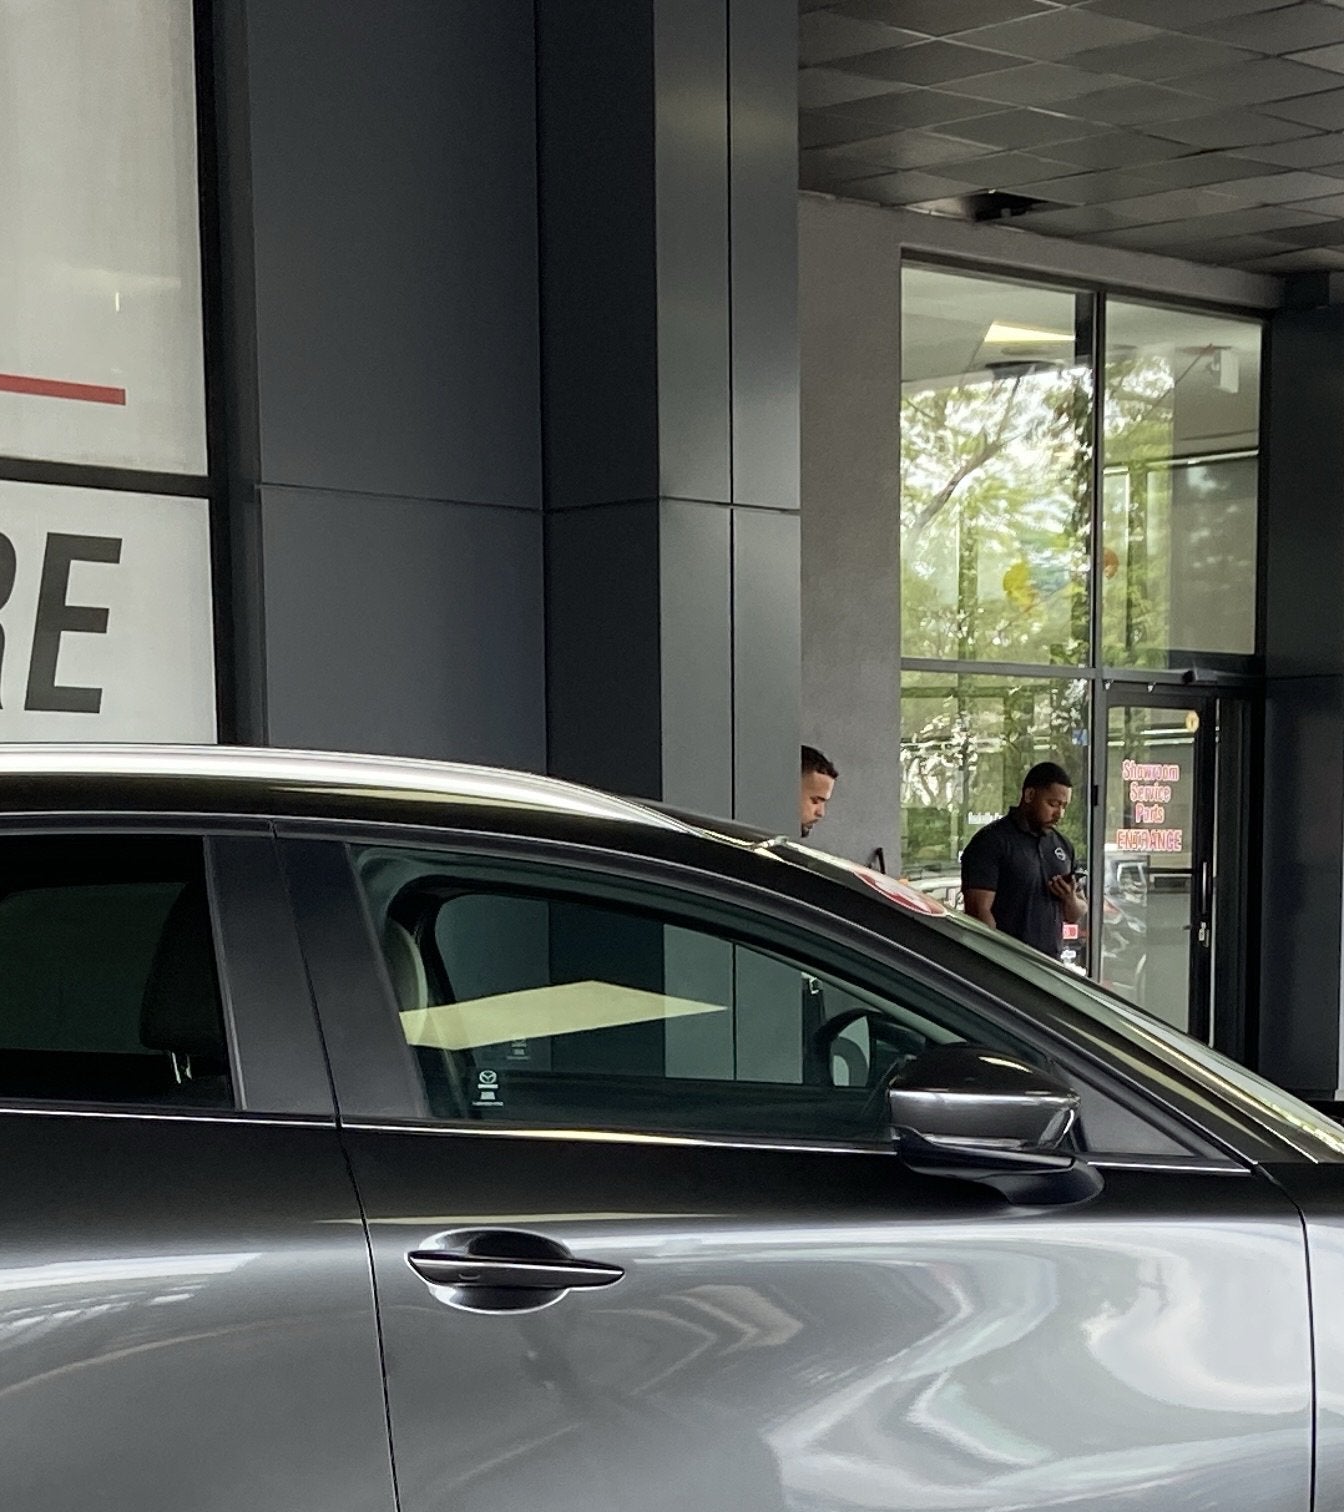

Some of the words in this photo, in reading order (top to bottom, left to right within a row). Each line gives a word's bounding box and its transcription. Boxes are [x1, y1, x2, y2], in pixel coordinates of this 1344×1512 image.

[1122, 759, 1180, 781] Showroom
[1130, 781, 1171, 802] Service
[1136, 803, 1164, 823] Parts
[1116, 829, 1182, 851] ENTRANCE
